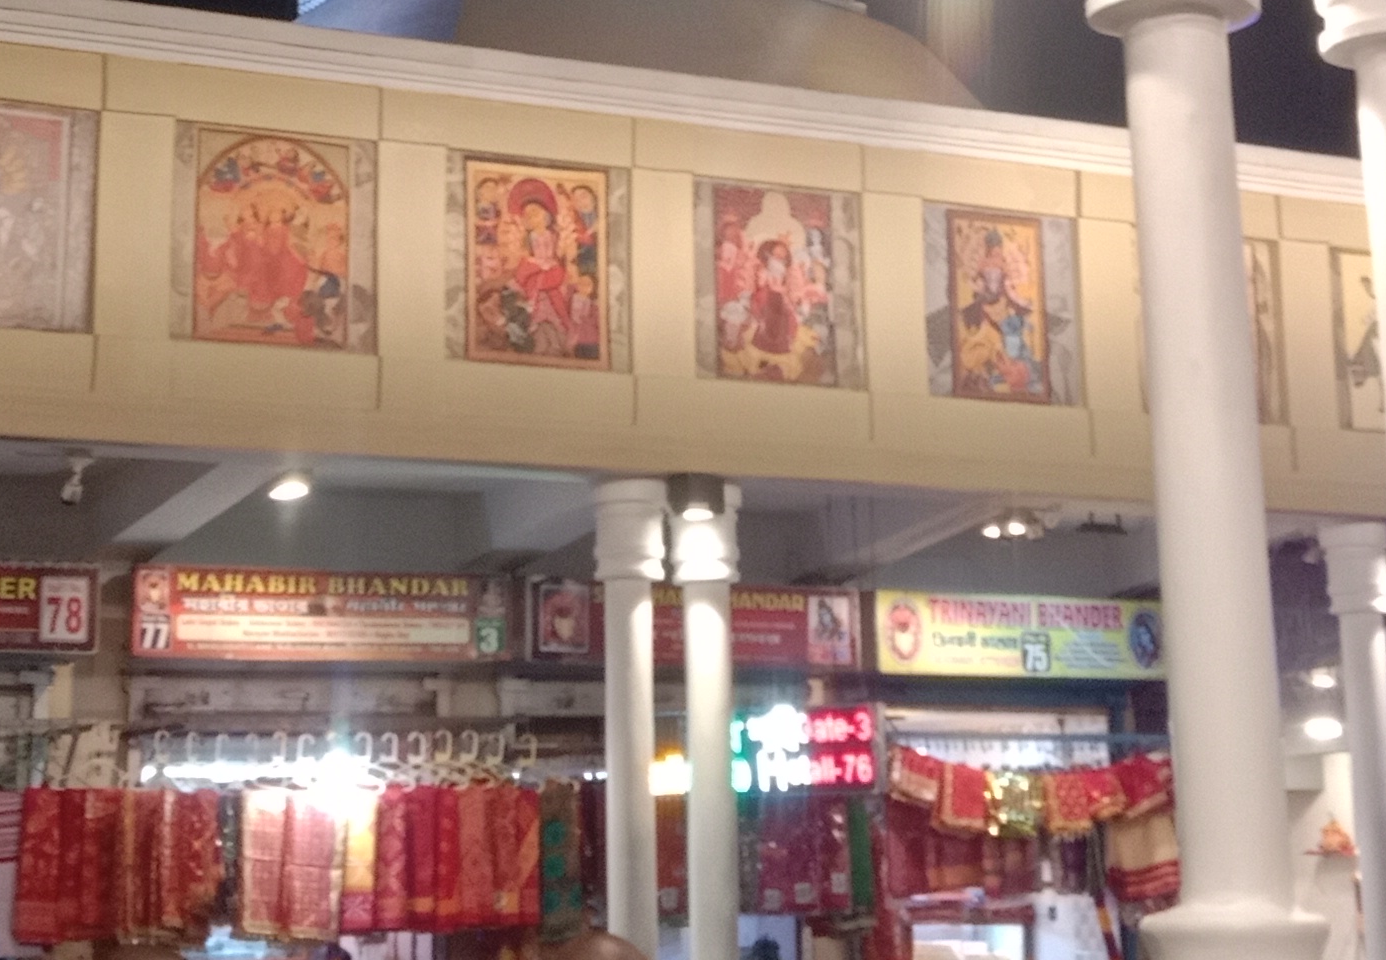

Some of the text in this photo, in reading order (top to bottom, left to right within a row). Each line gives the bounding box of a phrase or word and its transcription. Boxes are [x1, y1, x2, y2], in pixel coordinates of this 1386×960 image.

[177, 572, 469, 597] MAHABIR BHANDAR
[45, 596, 83, 635] 78
[929, 598, 1124, 631] TRINAYANI BHANDER
[142, 622, 170, 650] 77
[479, 626, 499, 653] 3
[1023, 642, 1048, 673] 75
